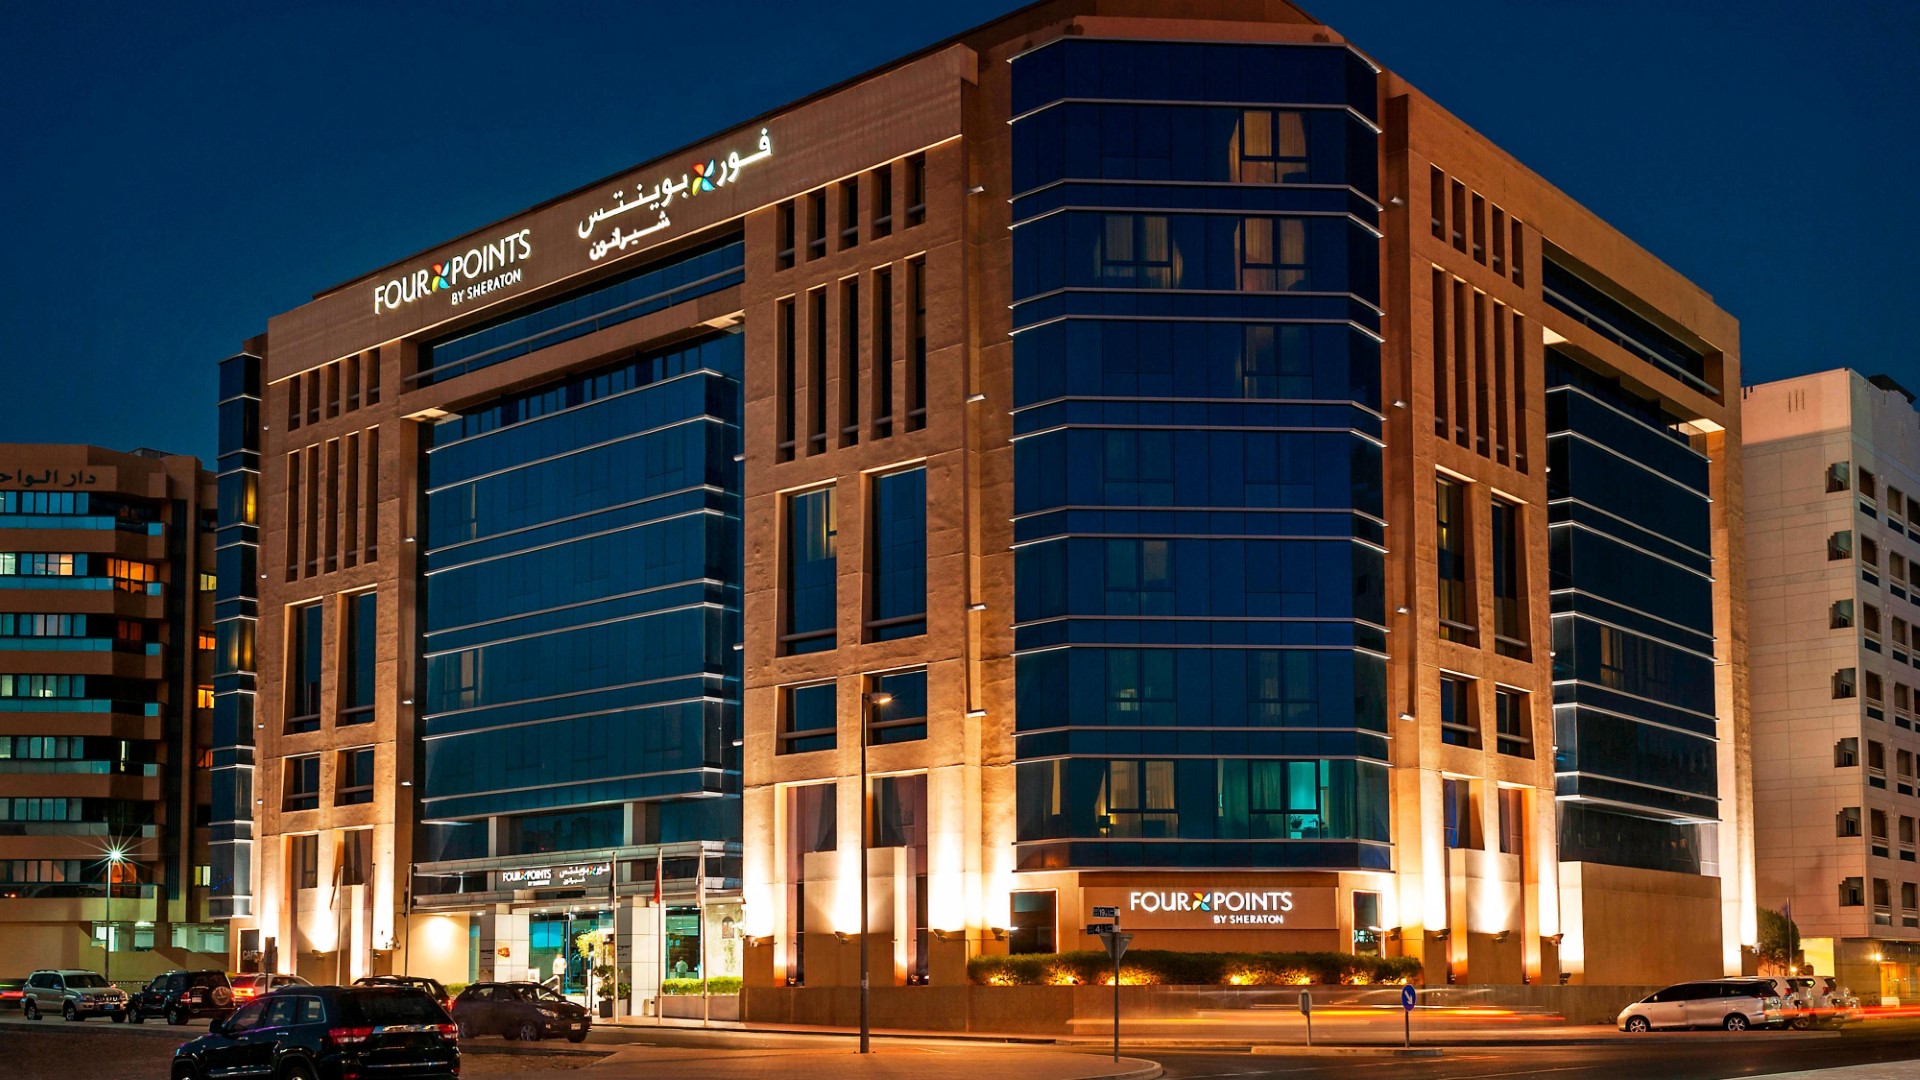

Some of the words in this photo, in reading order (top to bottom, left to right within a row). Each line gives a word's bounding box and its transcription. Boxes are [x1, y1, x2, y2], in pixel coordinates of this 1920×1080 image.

[716, 127, 773, 187] فور
[578, 173, 690, 239] بوينتس
[589, 210, 671, 261] شيراتون
[374, 269, 433, 315] FOUR
[451, 228, 532, 285] POINTS
[451, 289, 465, 306] BY
[466, 268, 522, 300] SHERATON
[62, 469, 97, 487] دار
[502, 870, 521, 882] FOUR
[526, 868, 552, 881] POINTS
[1130, 892, 1192, 912] FOUR
[1213, 892, 1293, 912] POINTS
[1213, 915, 1227, 924] BY
[1230, 915, 1284, 924] SHERATON
